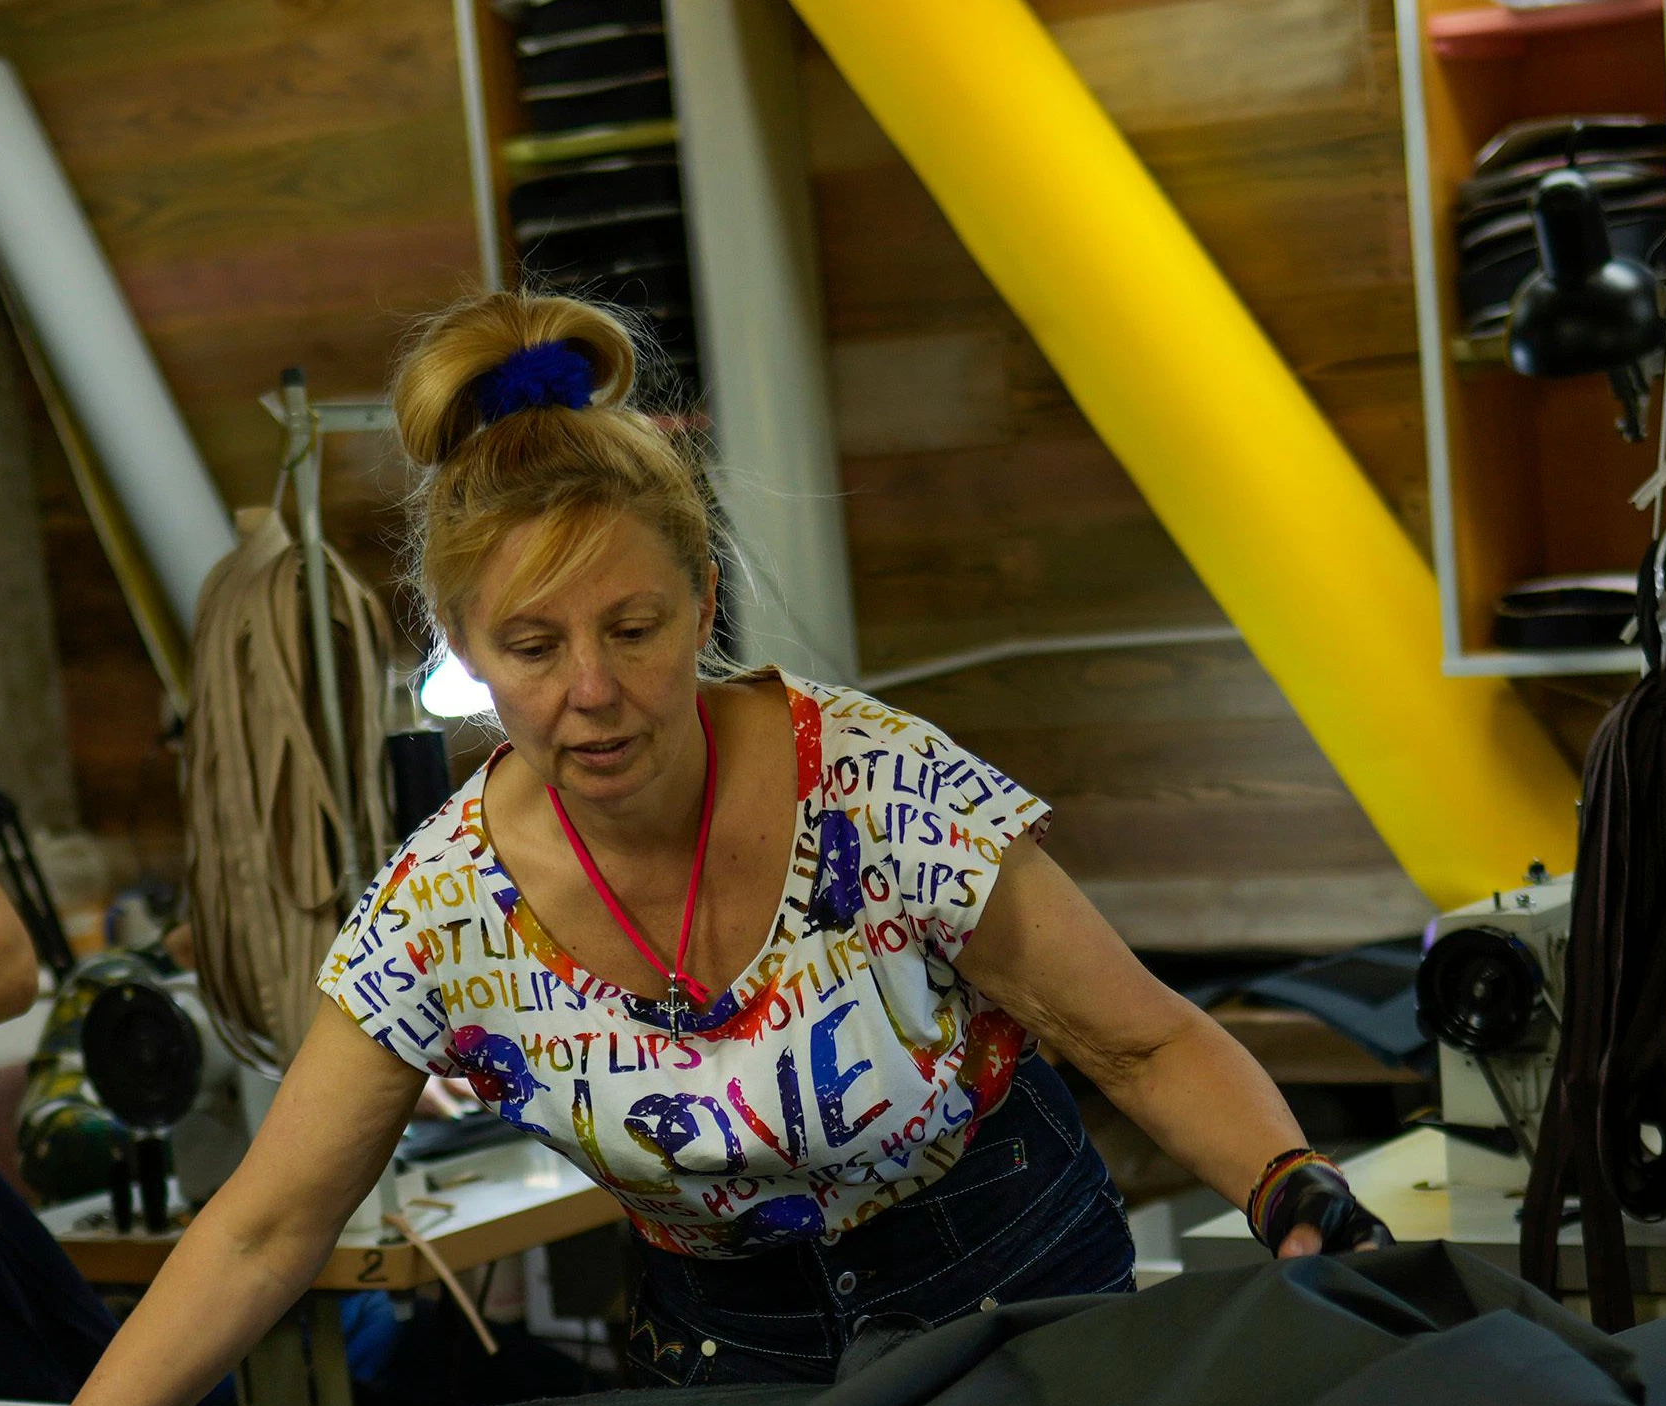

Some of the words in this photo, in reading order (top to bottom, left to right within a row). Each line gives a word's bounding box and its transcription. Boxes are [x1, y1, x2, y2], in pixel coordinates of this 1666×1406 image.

[820, 749, 889, 808] HOT
[865, 802, 944, 845] LIPS
[950, 821, 1003, 866] HO
[409, 864, 477, 912] HOT
[893, 859, 983, 908] LIPS
[338, 957, 416, 1025] LIPS
[405, 918, 472, 976] HOT
[441, 969, 509, 1015] HOT
[510, 971, 586, 1013] LIPS
[767, 969, 805, 1031] OT
[806, 929, 870, 1004] LIPS
[396, 987, 450, 1050] LIP
[520, 1032, 602, 1076] HOT
[608, 1031, 703, 1075] LIPS
[571, 999, 893, 1195] LOVE
[880, 1090, 938, 1158] HOT
[357, 1249, 389, 1283] 2
